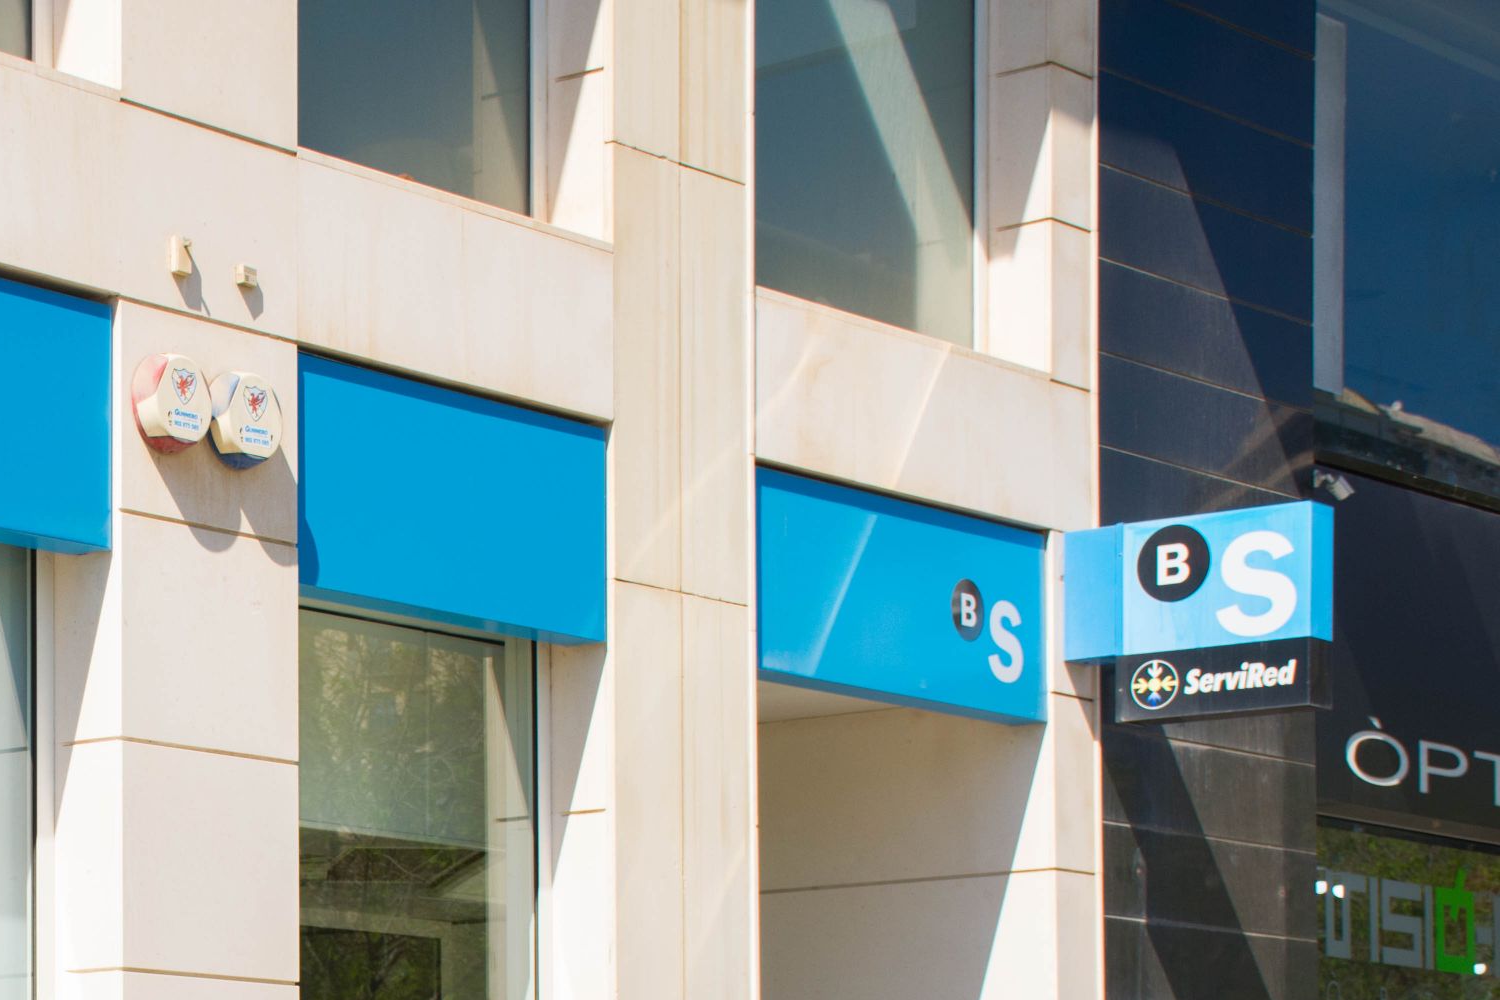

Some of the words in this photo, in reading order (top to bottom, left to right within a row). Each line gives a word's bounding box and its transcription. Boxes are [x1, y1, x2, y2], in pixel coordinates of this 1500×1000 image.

[1215, 530, 1297, 637] S
[988, 600, 1024, 683] S
[1183, 659, 1297, 695] ServiRed
